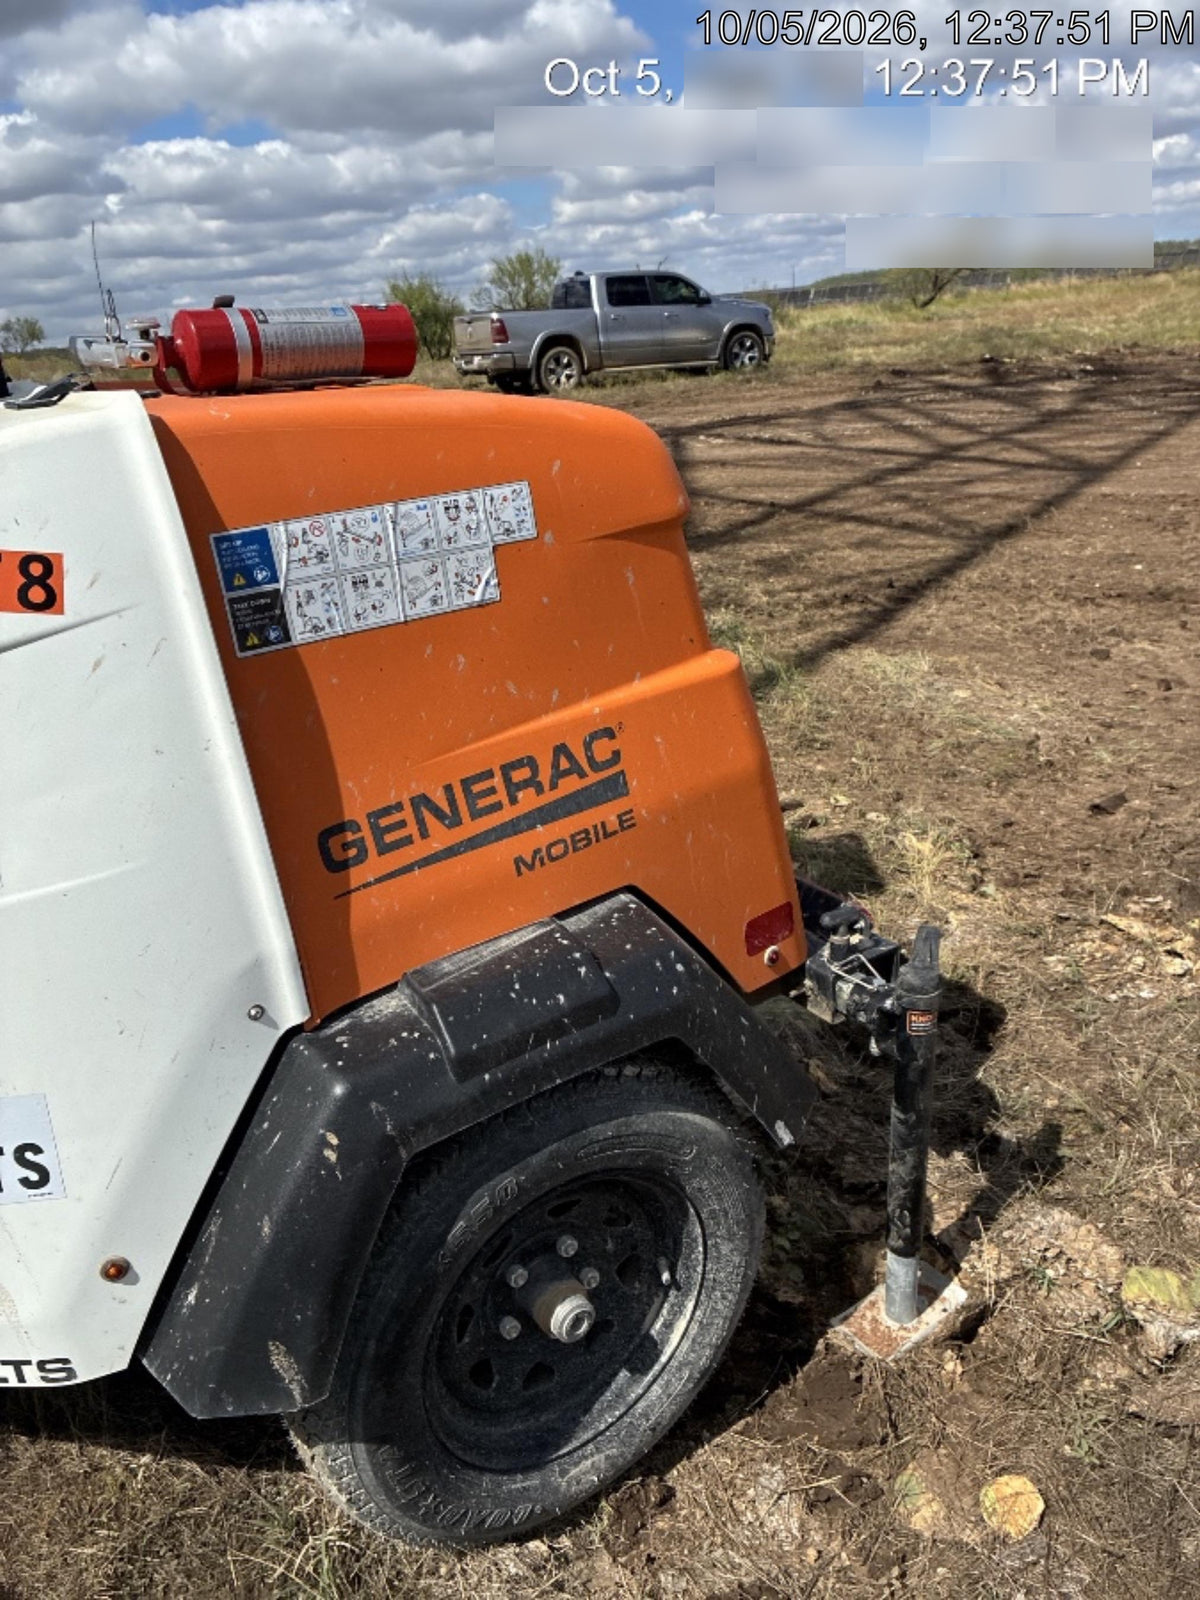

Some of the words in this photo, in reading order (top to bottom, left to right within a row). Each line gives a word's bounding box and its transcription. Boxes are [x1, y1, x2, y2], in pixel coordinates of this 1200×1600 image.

[0, 552, 57, 612] 8
[317, 725, 622, 874] GENERAC
[513, 808, 637, 877] MOBILE
[0, 1142, 50, 1190] S
